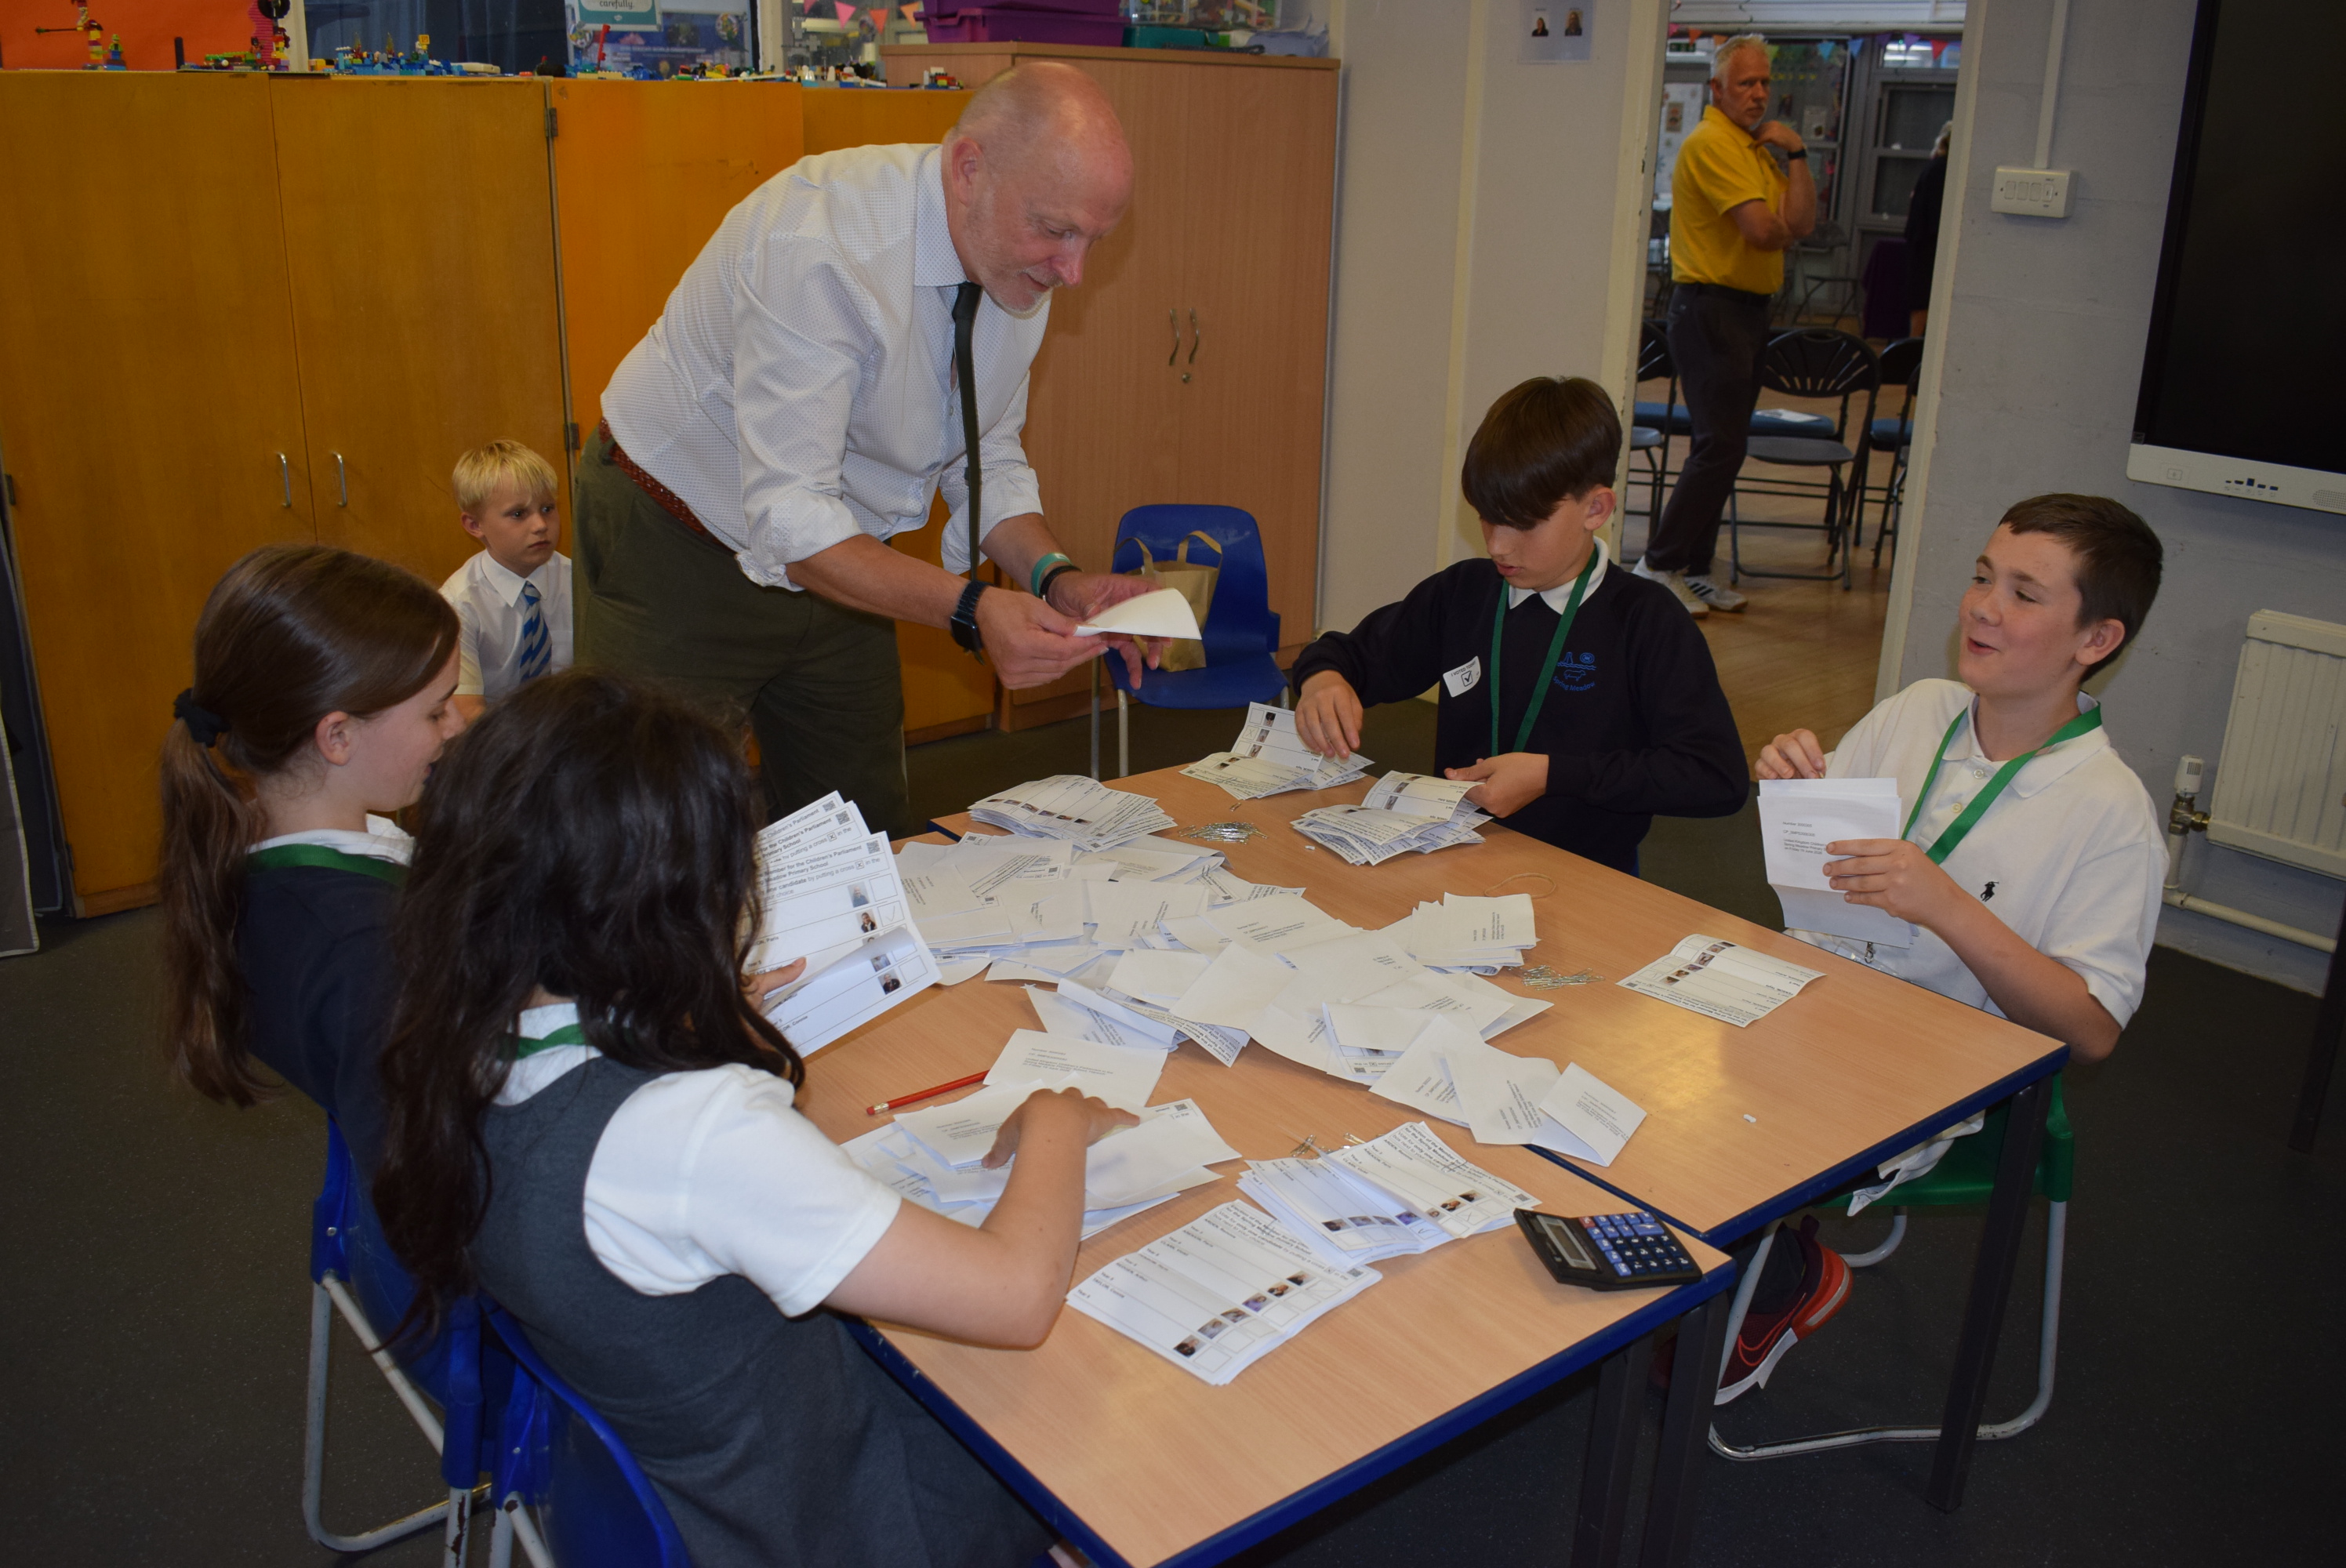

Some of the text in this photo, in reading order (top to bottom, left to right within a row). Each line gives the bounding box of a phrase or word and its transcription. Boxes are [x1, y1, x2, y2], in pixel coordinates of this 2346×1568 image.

[1552, 675, 1596, 692] Spring Meadow
[792, 809, 819, 824] Parliament
[778, 829, 803, 844] Children's
[804, 818, 831, 832] Parliament
[783, 838, 801, 848] School
[790, 846, 808, 856] putting
[813, 837, 826, 846] cross
[805, 853, 832, 864] Children's
[833, 845, 861, 856] Parliament
[779, 877, 806, 889] candidate
[815, 870, 833, 880] putting
[839, 863, 855, 873] cross
[788, 867, 808, 877] Primary
[809, 861, 828, 869] School
[775, 888, 794, 897] choice
[1408, 1125, 1426, 1138] Election
[1437, 1147, 1456, 1160] Member
